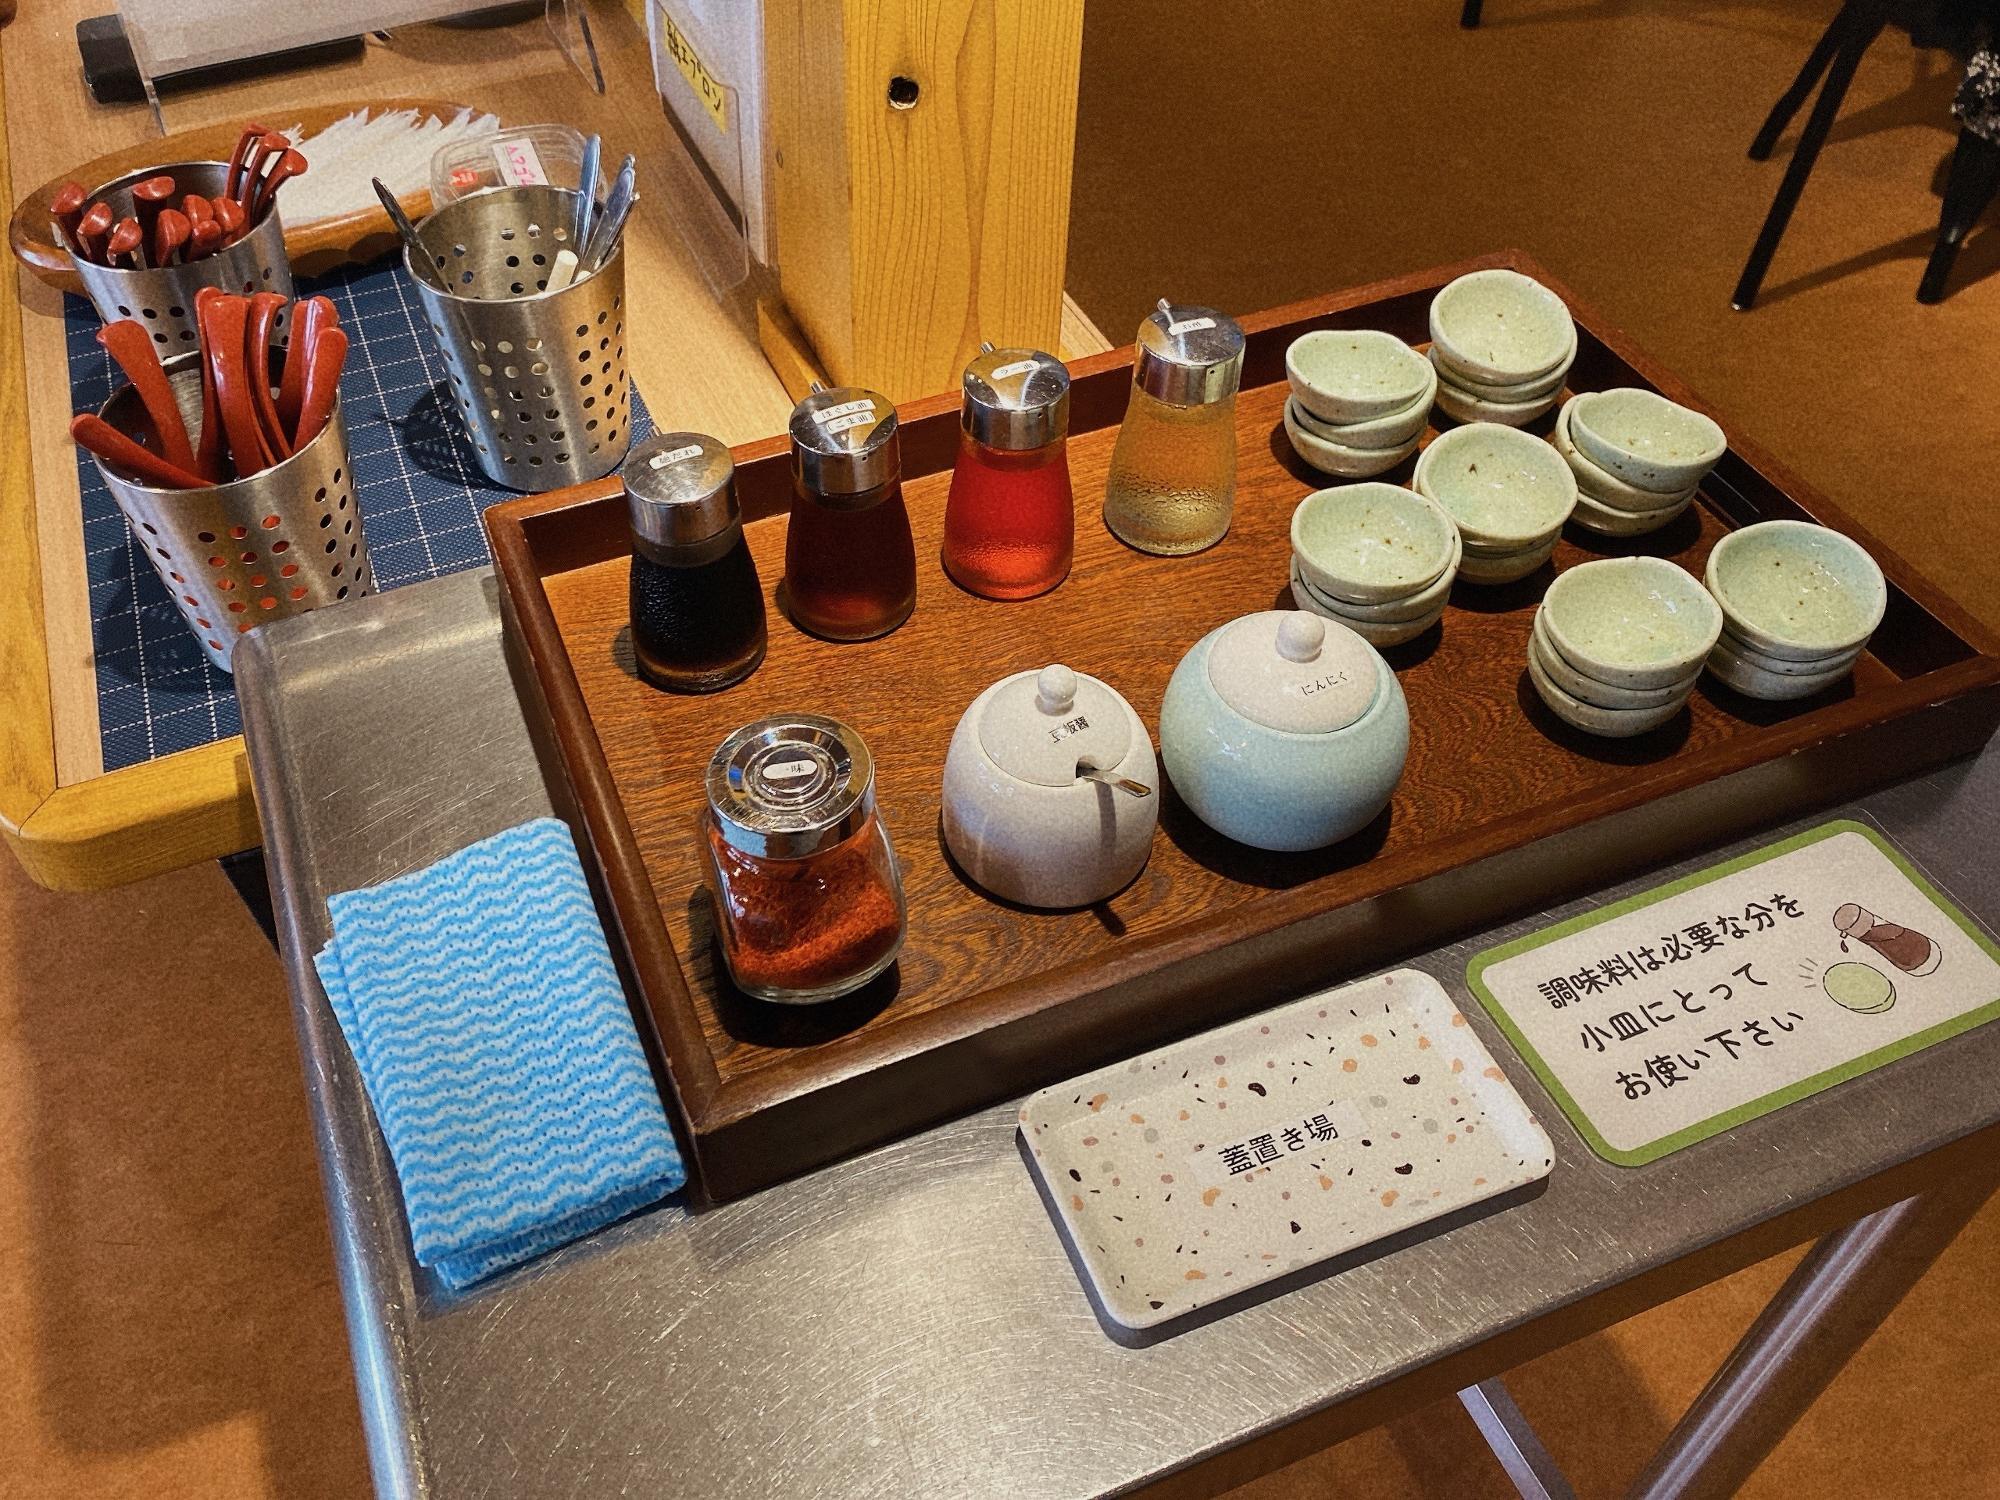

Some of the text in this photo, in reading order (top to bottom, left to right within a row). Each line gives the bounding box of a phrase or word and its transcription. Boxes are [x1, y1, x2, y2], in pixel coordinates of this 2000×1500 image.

[1301, 671, 1347, 696] にんにく
[1537, 893, 1804, 1009] 調味料は必要な分を
[1580, 962, 1768, 1053] 小皿にとって
[1615, 1011, 1804, 1100] お使い下さい
[1217, 1113, 1340, 1176] 蓋置き場
